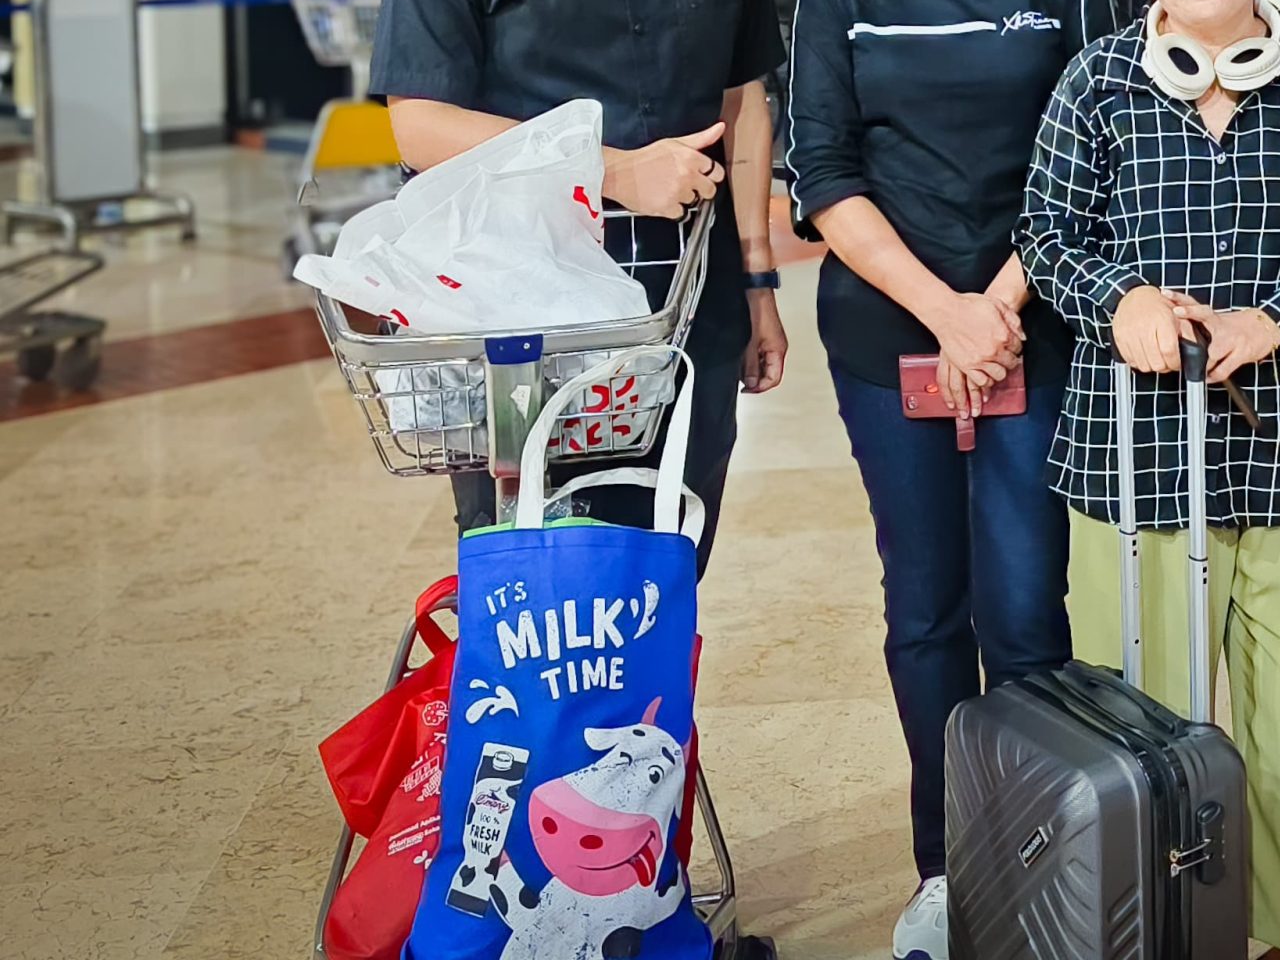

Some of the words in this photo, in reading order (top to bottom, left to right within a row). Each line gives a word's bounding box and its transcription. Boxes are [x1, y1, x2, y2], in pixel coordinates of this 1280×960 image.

[486, 581, 528, 616] IT'S
[496, 597, 626, 670] MILK
[540, 655, 625, 701] TIME
[469, 823, 501, 842] FRESH
[471, 839, 493, 856] MILK
